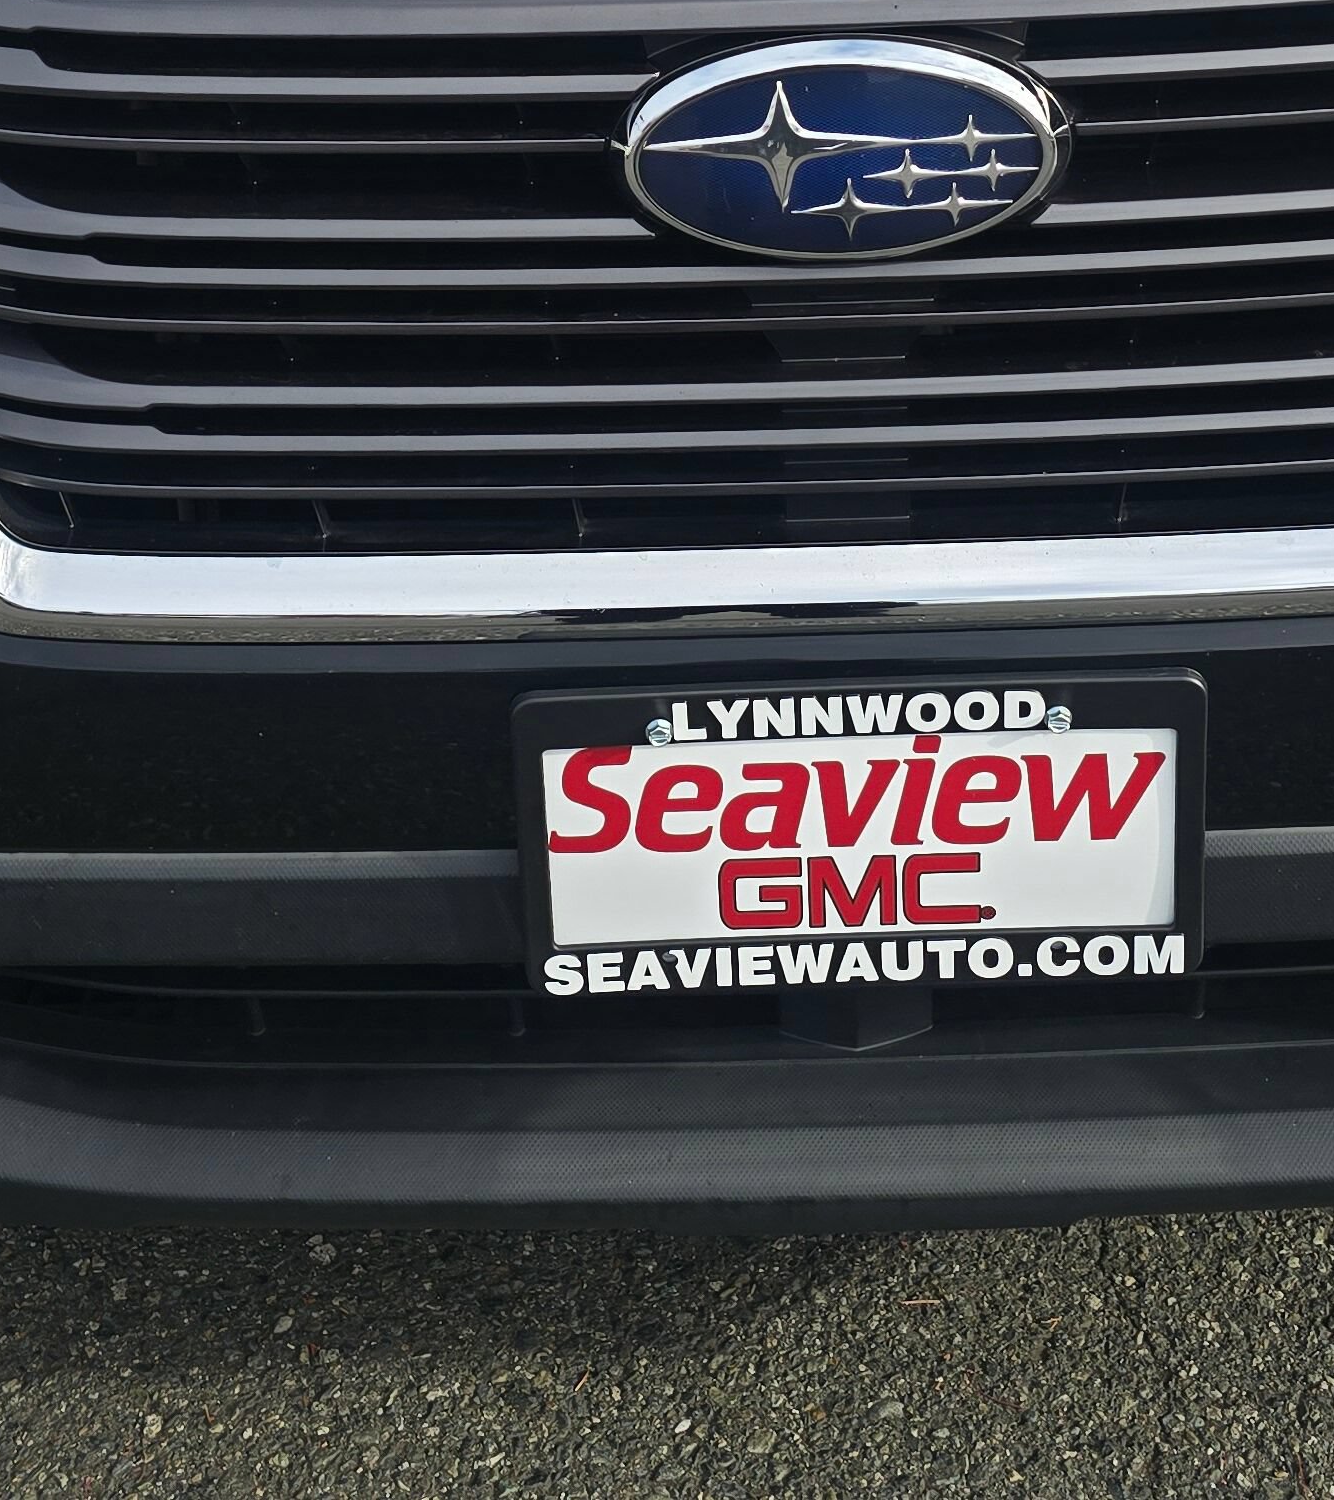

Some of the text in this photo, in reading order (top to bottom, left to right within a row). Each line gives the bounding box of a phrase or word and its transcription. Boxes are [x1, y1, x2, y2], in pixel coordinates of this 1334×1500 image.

[672, 690, 1047, 742] LYNNWOOD
[548, 735, 1167, 854] Seaview
[718, 852, 983, 931] GMC
[544, 935, 1185, 996] SEAVIEWAUTO.COM
